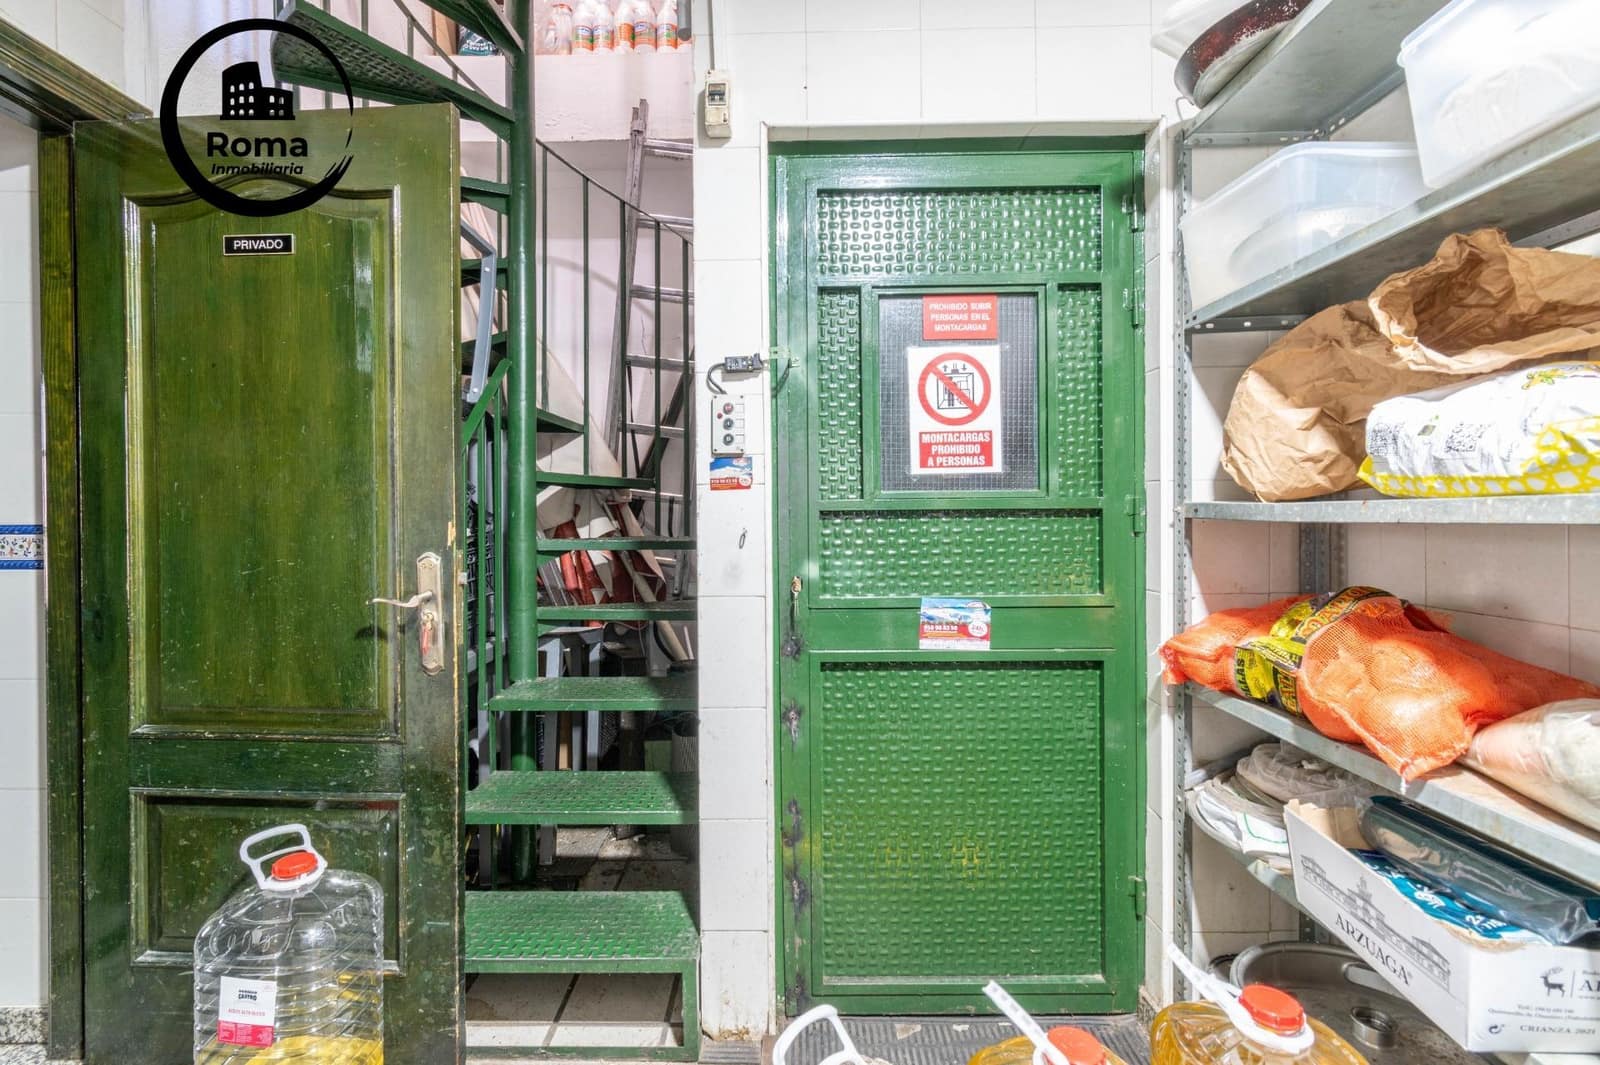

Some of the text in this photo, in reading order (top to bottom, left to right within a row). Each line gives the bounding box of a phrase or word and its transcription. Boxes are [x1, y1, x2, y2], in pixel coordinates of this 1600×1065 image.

[233, 239, 283, 250] PRIVADO
[929, 302, 992, 311] PROHIBIDO SUBIR
[930, 312, 991, 321] PERSONAS EN EL
[934, 323, 987, 332] MONTACARGAS
[921, 432, 991, 443] MONTACARGAS
[931, 444, 981, 455] PROHIBIDO
[927, 455, 985, 467] A PERSONAS
[1336, 912, 1409, 986] ARZUAGA
[1519, 1024, 1572, 1034] CRIANZA
